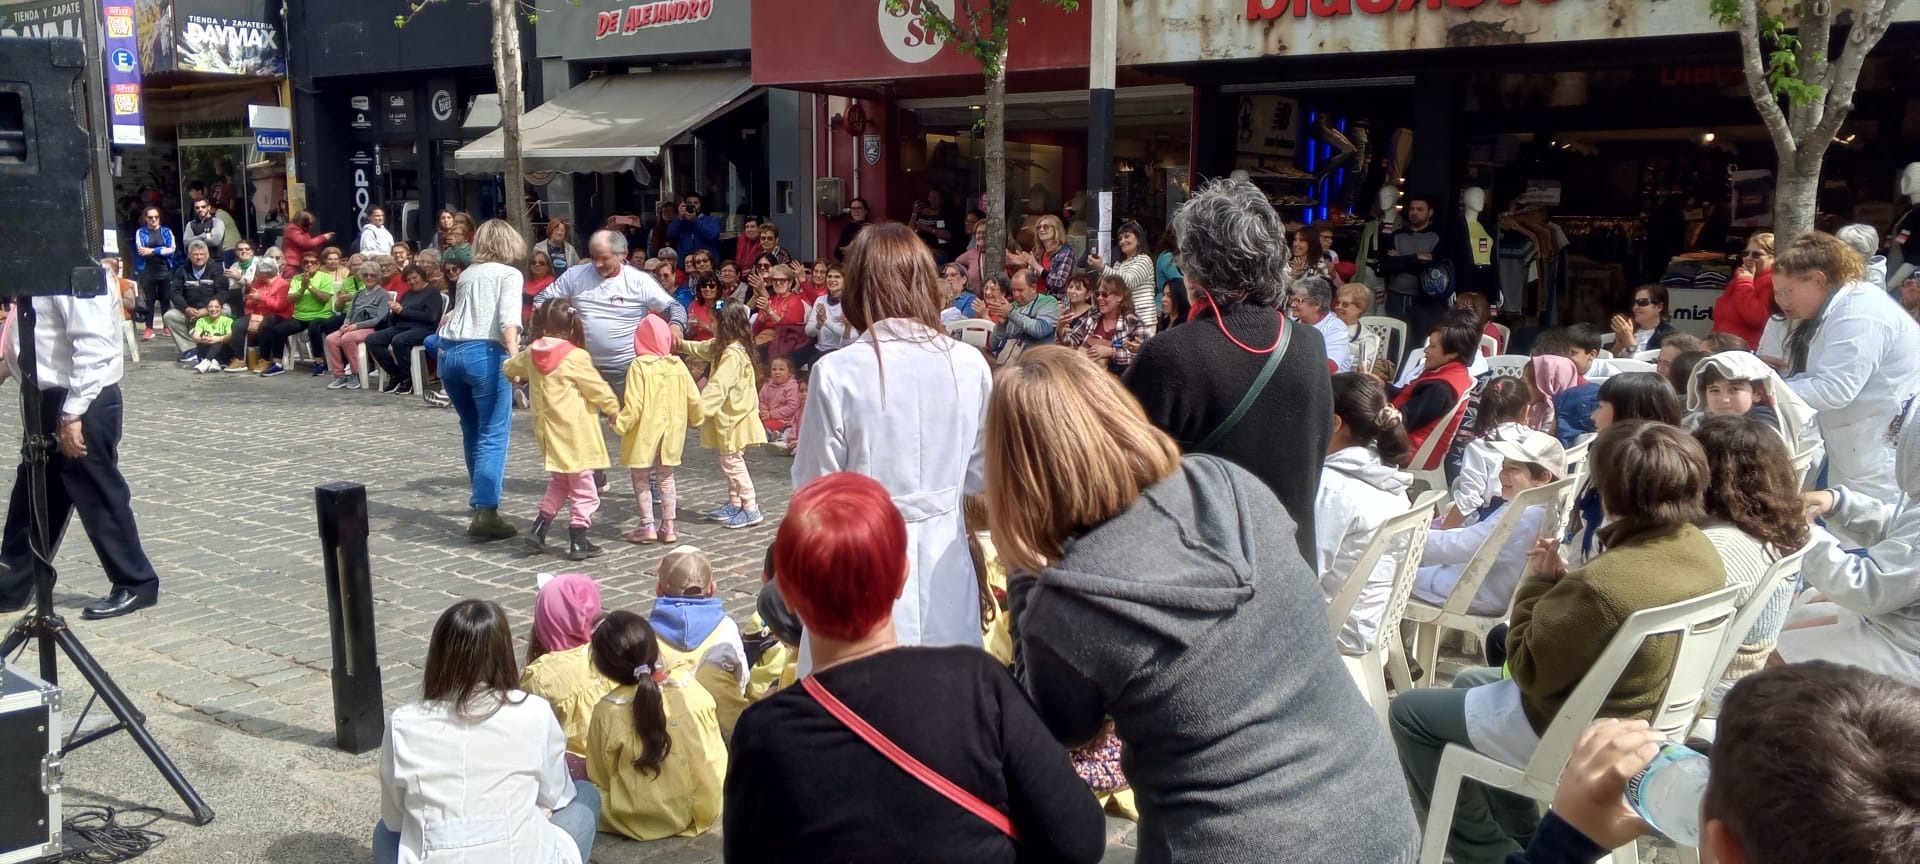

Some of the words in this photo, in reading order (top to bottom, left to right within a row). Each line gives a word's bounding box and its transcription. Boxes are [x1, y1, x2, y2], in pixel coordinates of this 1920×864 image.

[14, 9, 39, 22] TIENDA
[43, 7, 48, 19] Y
[53, 2, 80, 16] ZAPATE
[188, 15, 218, 24] TIENDA
[232, 20, 273, 29] ZAPATERIA
[596, 9, 621, 40] DE
[622, 0, 713, 36] ALEJANDRO
[187, 22, 278, 49] DAYMAX
[118, 53, 128, 66] E
